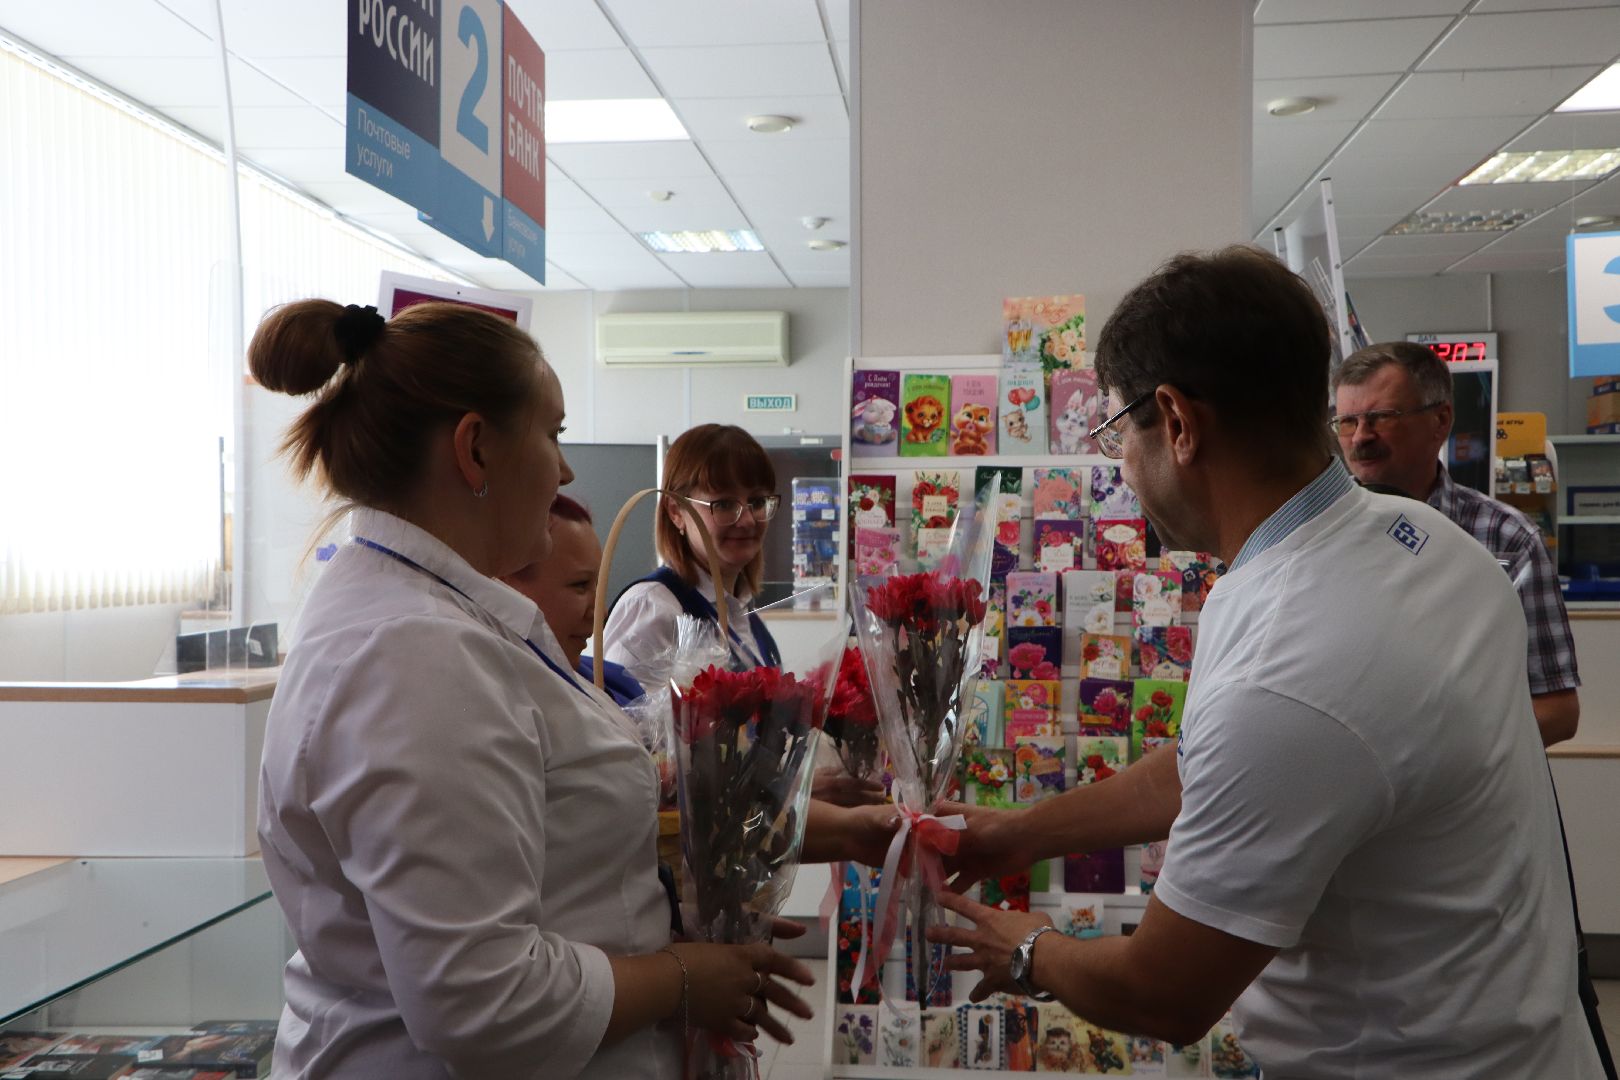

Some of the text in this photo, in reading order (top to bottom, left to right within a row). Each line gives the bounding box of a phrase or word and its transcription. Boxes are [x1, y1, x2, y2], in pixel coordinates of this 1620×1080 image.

[359, 0, 434, 88] РОССИИ
[457, 5, 489, 156] 2
[508, 53, 545, 132] ПОЧТА
[357, 108, 411, 160] Почтовые
[357, 143, 393, 178] услуги
[508, 111, 540, 182] БАНК
[749, 397, 792, 410] ВЫХОД
